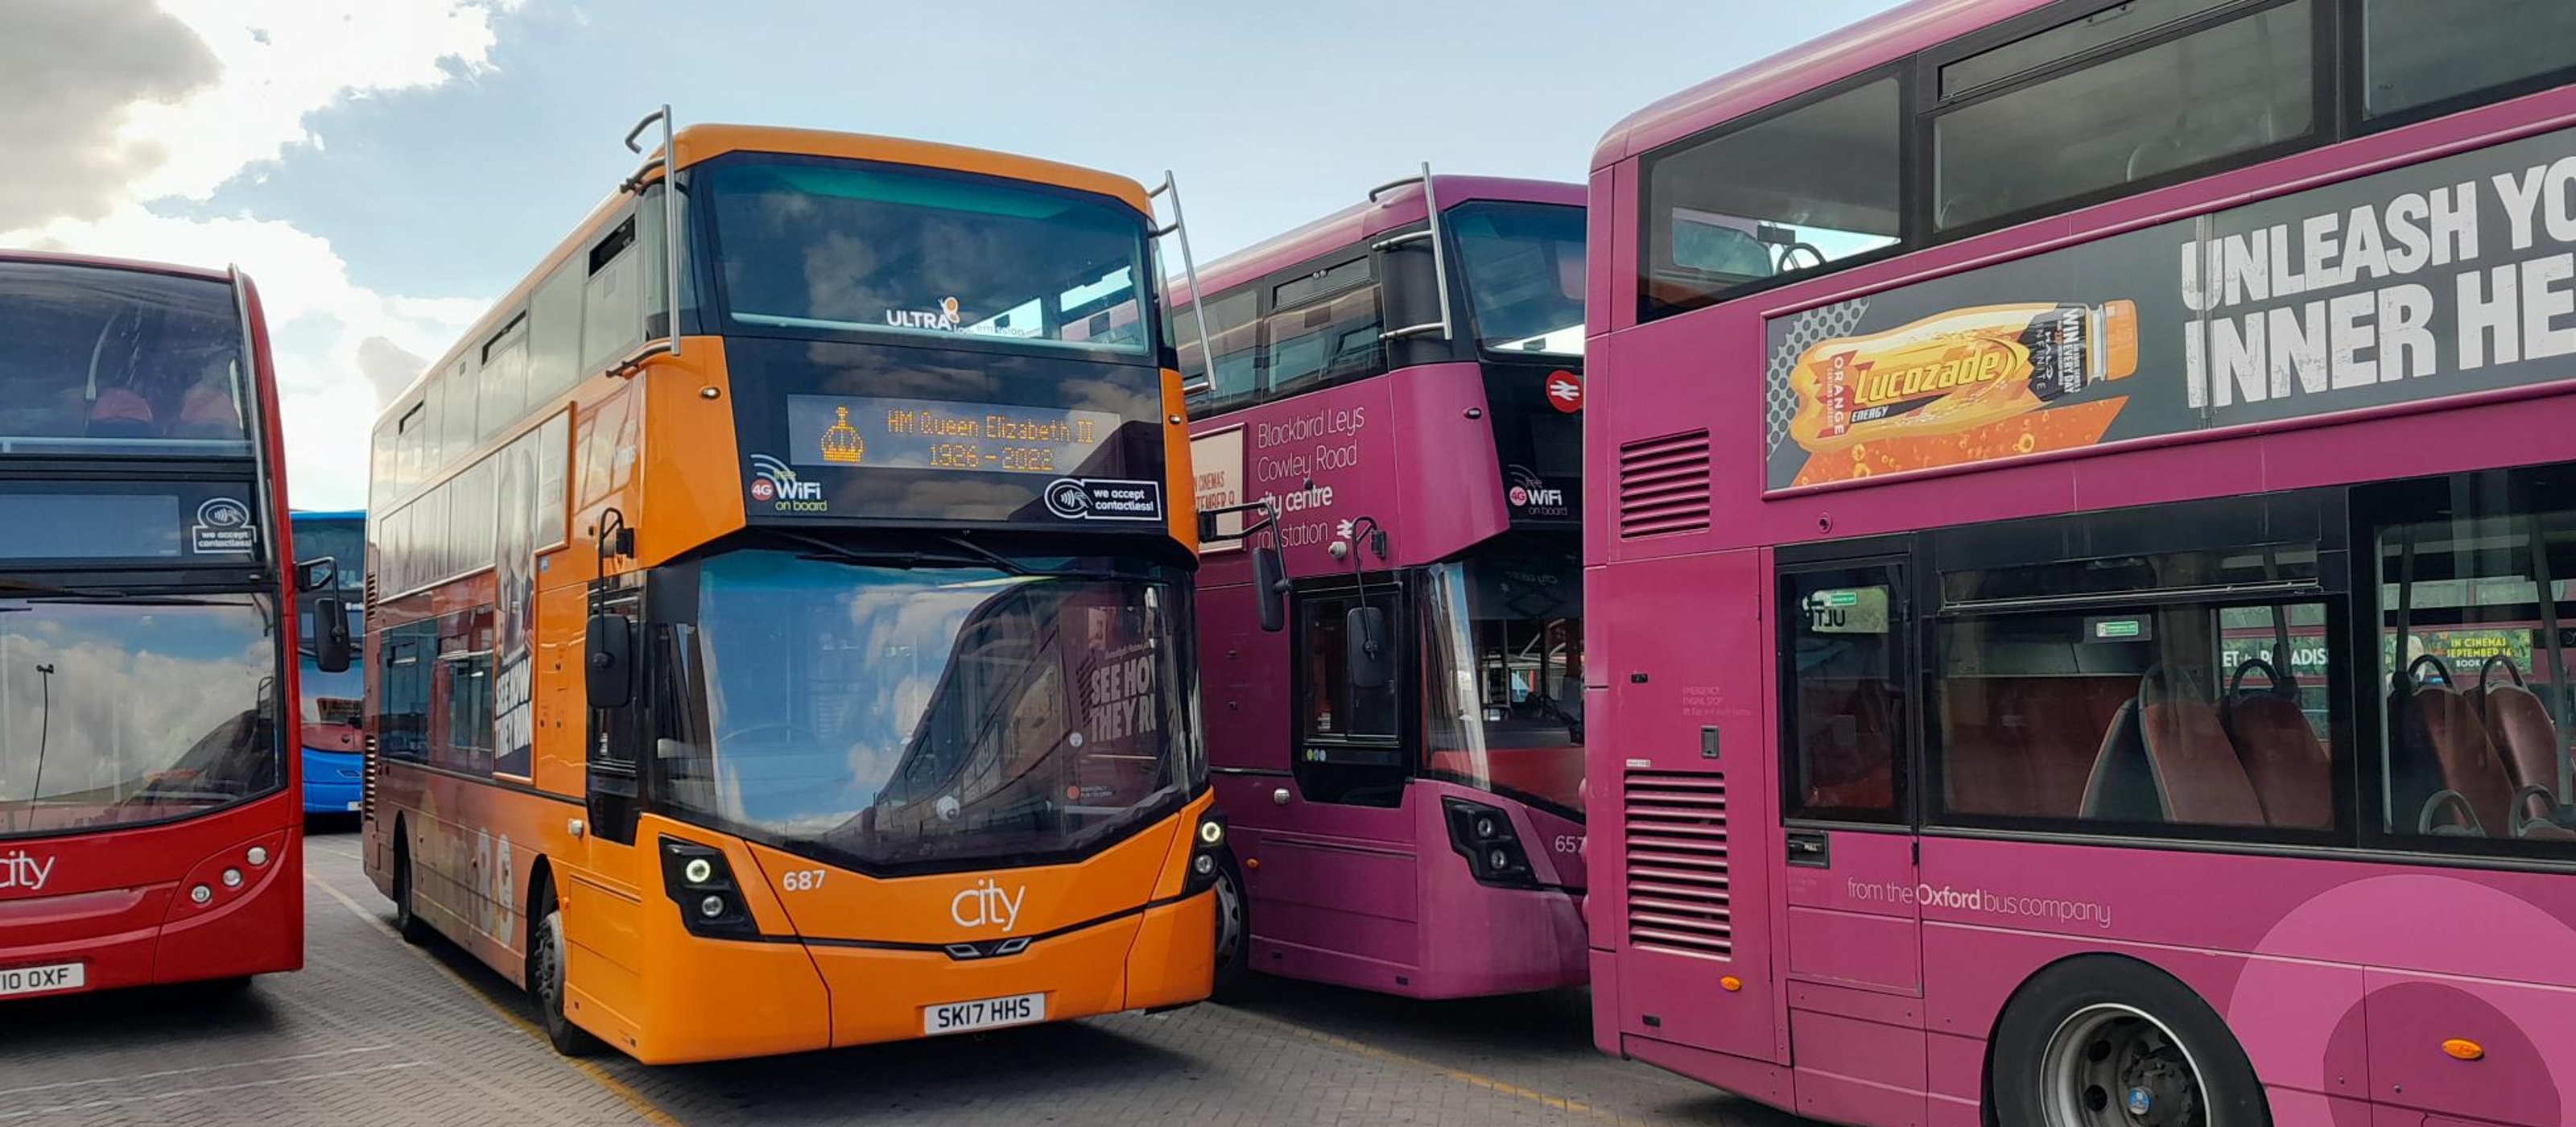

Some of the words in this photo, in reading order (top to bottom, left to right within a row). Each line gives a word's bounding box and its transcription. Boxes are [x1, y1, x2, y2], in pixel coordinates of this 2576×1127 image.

[2182, 180, 2479, 311] UNLEASH
[886, 309, 952, 331] ULTRA
[2062, 308, 2079, 345] WIN
[2045, 331, 2054, 380] HALO
[2063, 344, 2074, 374] EVERY
[2185, 283, 2437, 409] INNER
[1854, 348, 2001, 405] Lucozade
[2064, 375, 2074, 394] DAY
[1834, 357, 1845, 435] ORANGE
[889, 410, 914, 433] HM
[921, 411, 979, 438] Queen
[985, 415, 1071, 442] Elizabeth
[1077, 418, 1094, 444] II
[1258, 410, 1324, 449] Blackbird
[1328, 407, 1364, 436] Leys
[1852, 405, 1889, 423] ENERGY
[930, 444, 980, 469] 1926
[1002, 447, 1054, 472] 2022
[1257, 451, 1312, 483] Cowley
[1316, 439, 1357, 471] Road
[752, 484, 773, 496] 4G
[775, 481, 821, 499] WiFi
[775, 501, 791, 511] on
[793, 499, 828, 511] board
[1093, 489, 1109, 498] we
[1112, 489, 1145, 501] accept
[1096, 501, 1154, 511] contactless!
[1257, 490, 1282, 520] city
[1286, 485, 1333, 512] centre
[1528, 489, 1563, 506] WiFi
[1542, 506, 1567, 515] board
[1281, 522, 1328, 548] station
[1091, 662, 1121, 707] SEE
[1090, 696, 1137, 742] THEY
[783, 869, 826, 892] 687
[952, 877, 1026, 932] city
[1847, 877, 1884, 902] from
[1887, 881, 1913, 904] the
[1916, 883, 1981, 910] Oxford
[1984, 890, 2017, 914] bus
[2019, 897, 2111, 929] company
[28, 968, 69, 989] OXF
[937, 1003, 985, 1029] SK17
[991, 997, 1030, 1022] HHS
